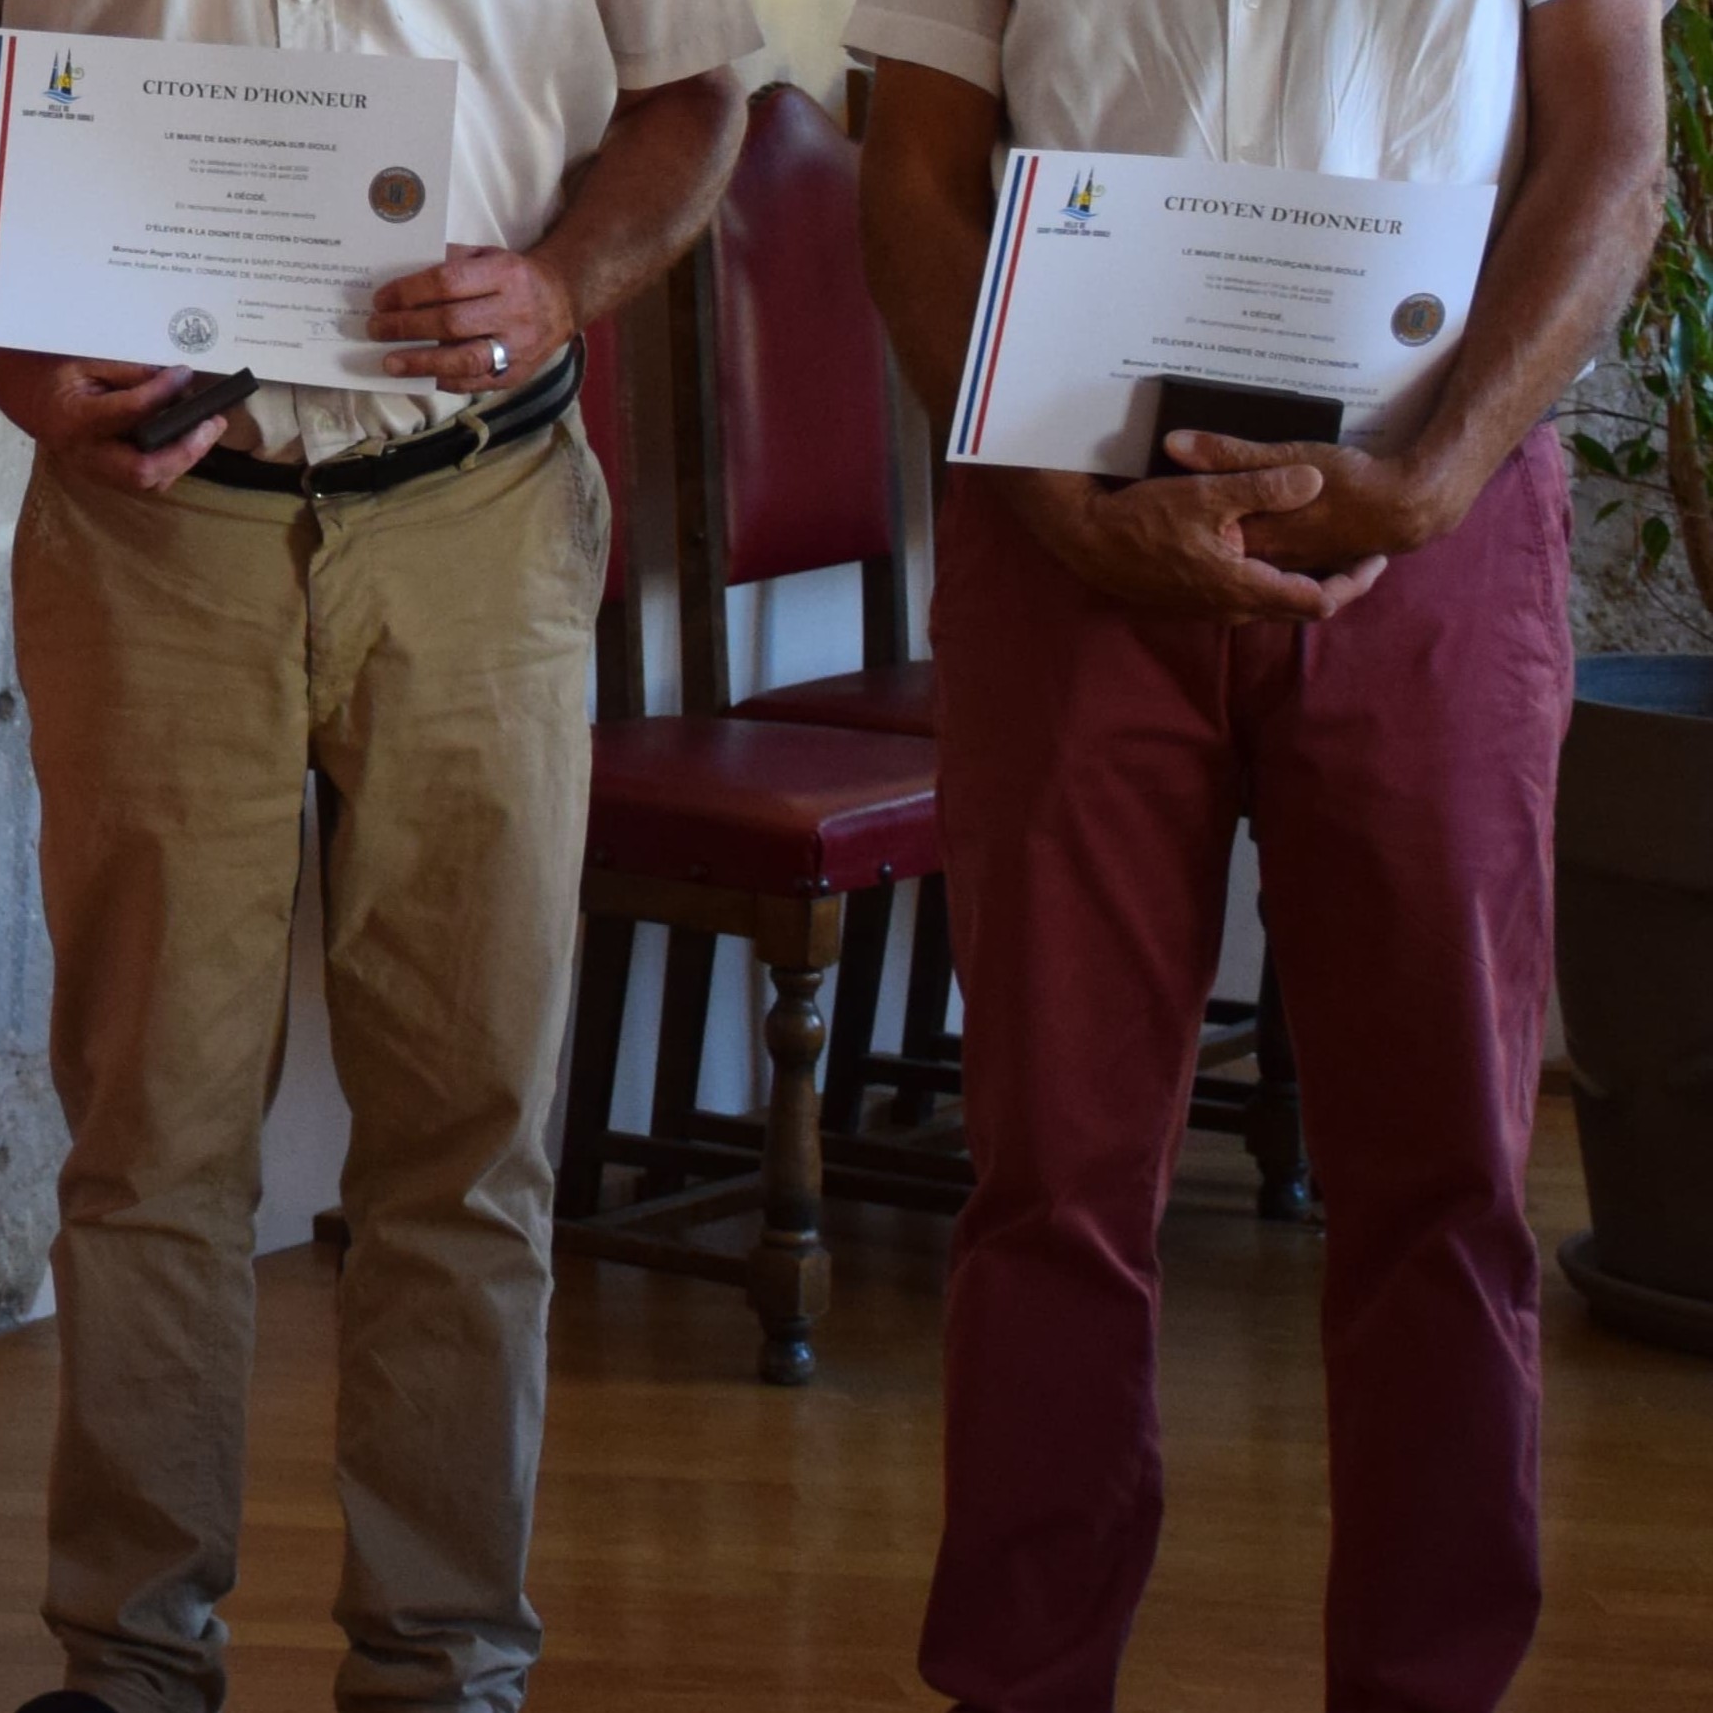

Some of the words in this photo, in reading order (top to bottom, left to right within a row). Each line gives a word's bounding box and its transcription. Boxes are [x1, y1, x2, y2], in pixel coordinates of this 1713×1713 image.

[141, 77, 237, 101] CITOYEN
[243, 84, 368, 111] D'HONNEUR
[164, 131, 174, 139] LE
[176, 131, 201, 142] MAIRE
[203, 134, 214, 143] DE
[1162, 195, 1265, 220] CITOYEN
[1269, 206, 1404, 235] D'HONNEUR
[194, 227, 205, 236] LA
[242, 231, 253, 240] DE
[255, 232, 291, 243] CITOYEN
[1180, 247, 1192, 256] LE
[1193, 248, 1221, 259] MAIRE
[1222, 251, 1235, 260] DE
[1203, 342, 1216, 350] LA
